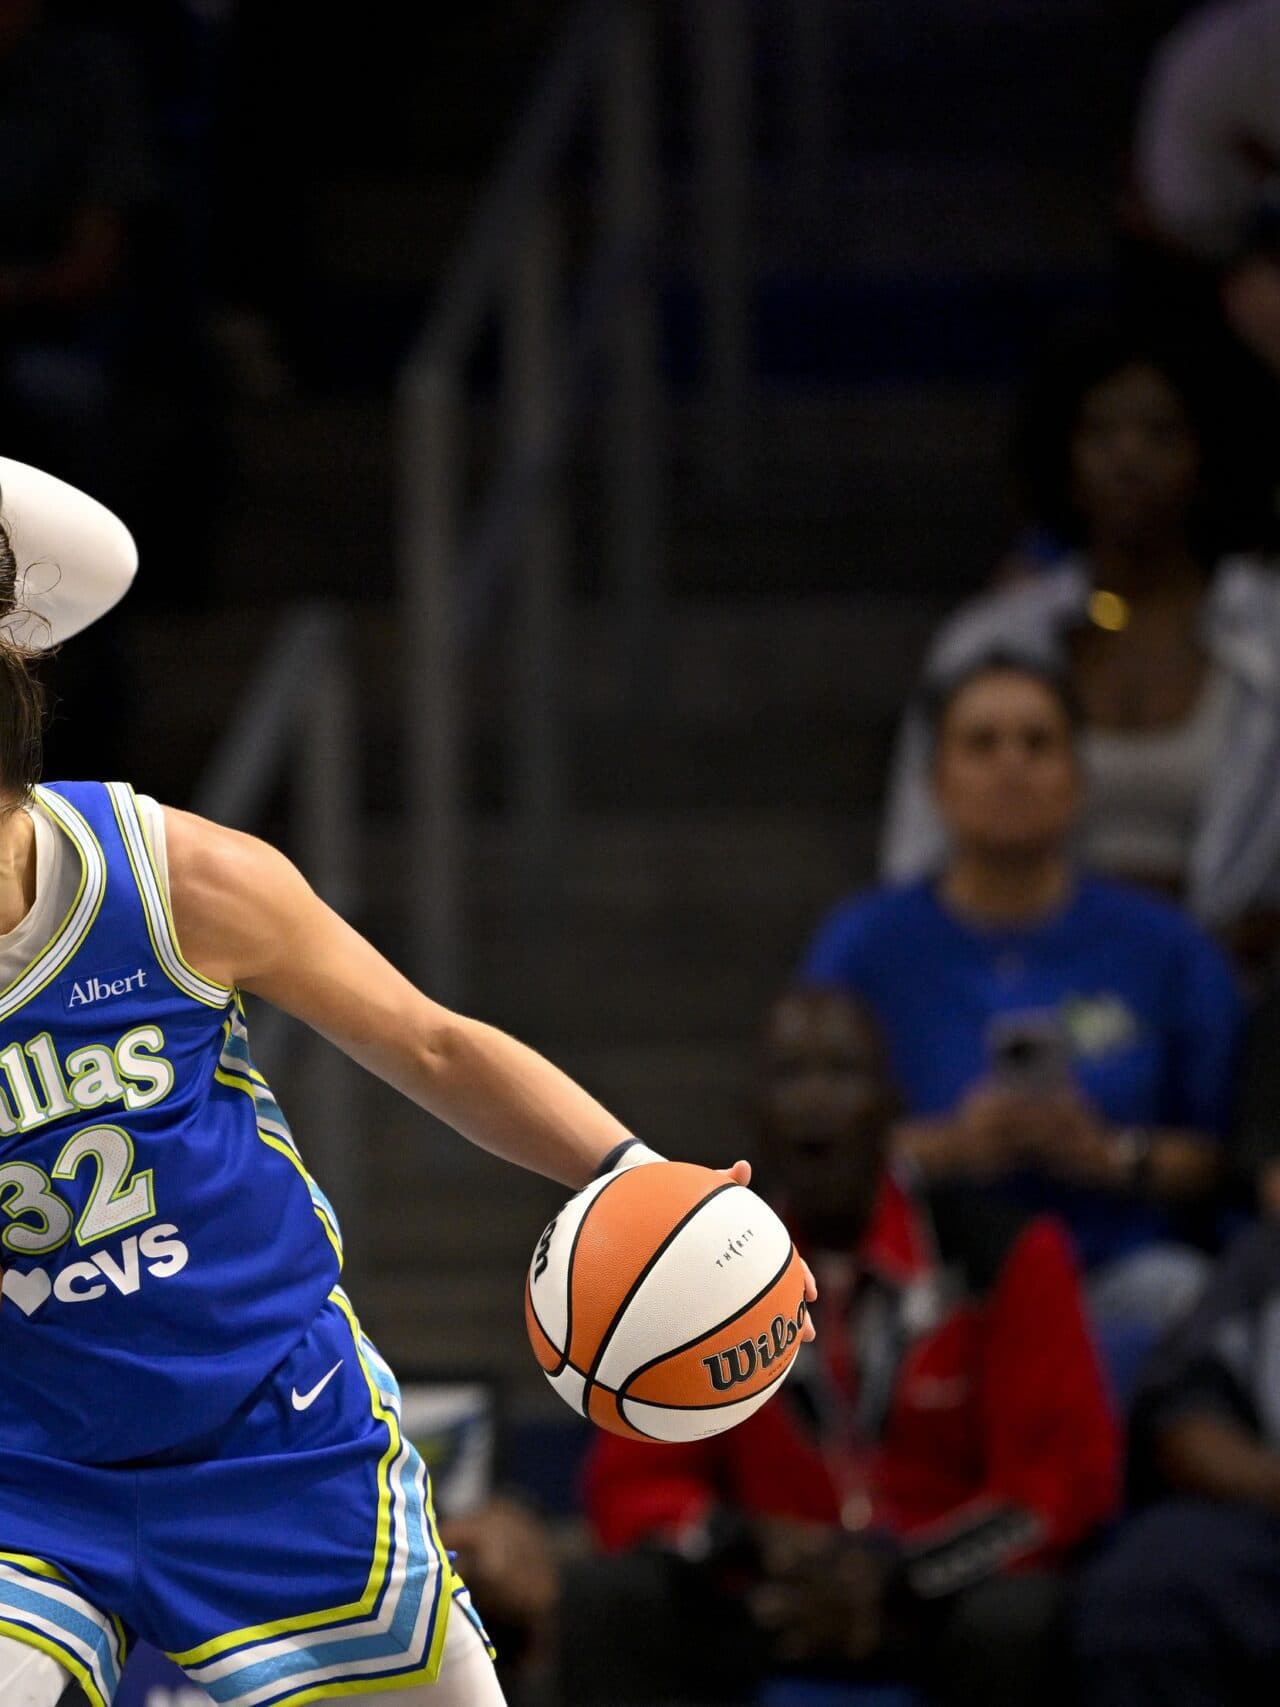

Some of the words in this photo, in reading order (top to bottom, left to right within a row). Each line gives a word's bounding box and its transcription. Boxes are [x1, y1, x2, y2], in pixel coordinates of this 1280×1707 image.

[67, 968, 148, 1008] Albert
[53, 1223, 189, 1303] CVS
[701, 1299, 807, 1392] Wilso
